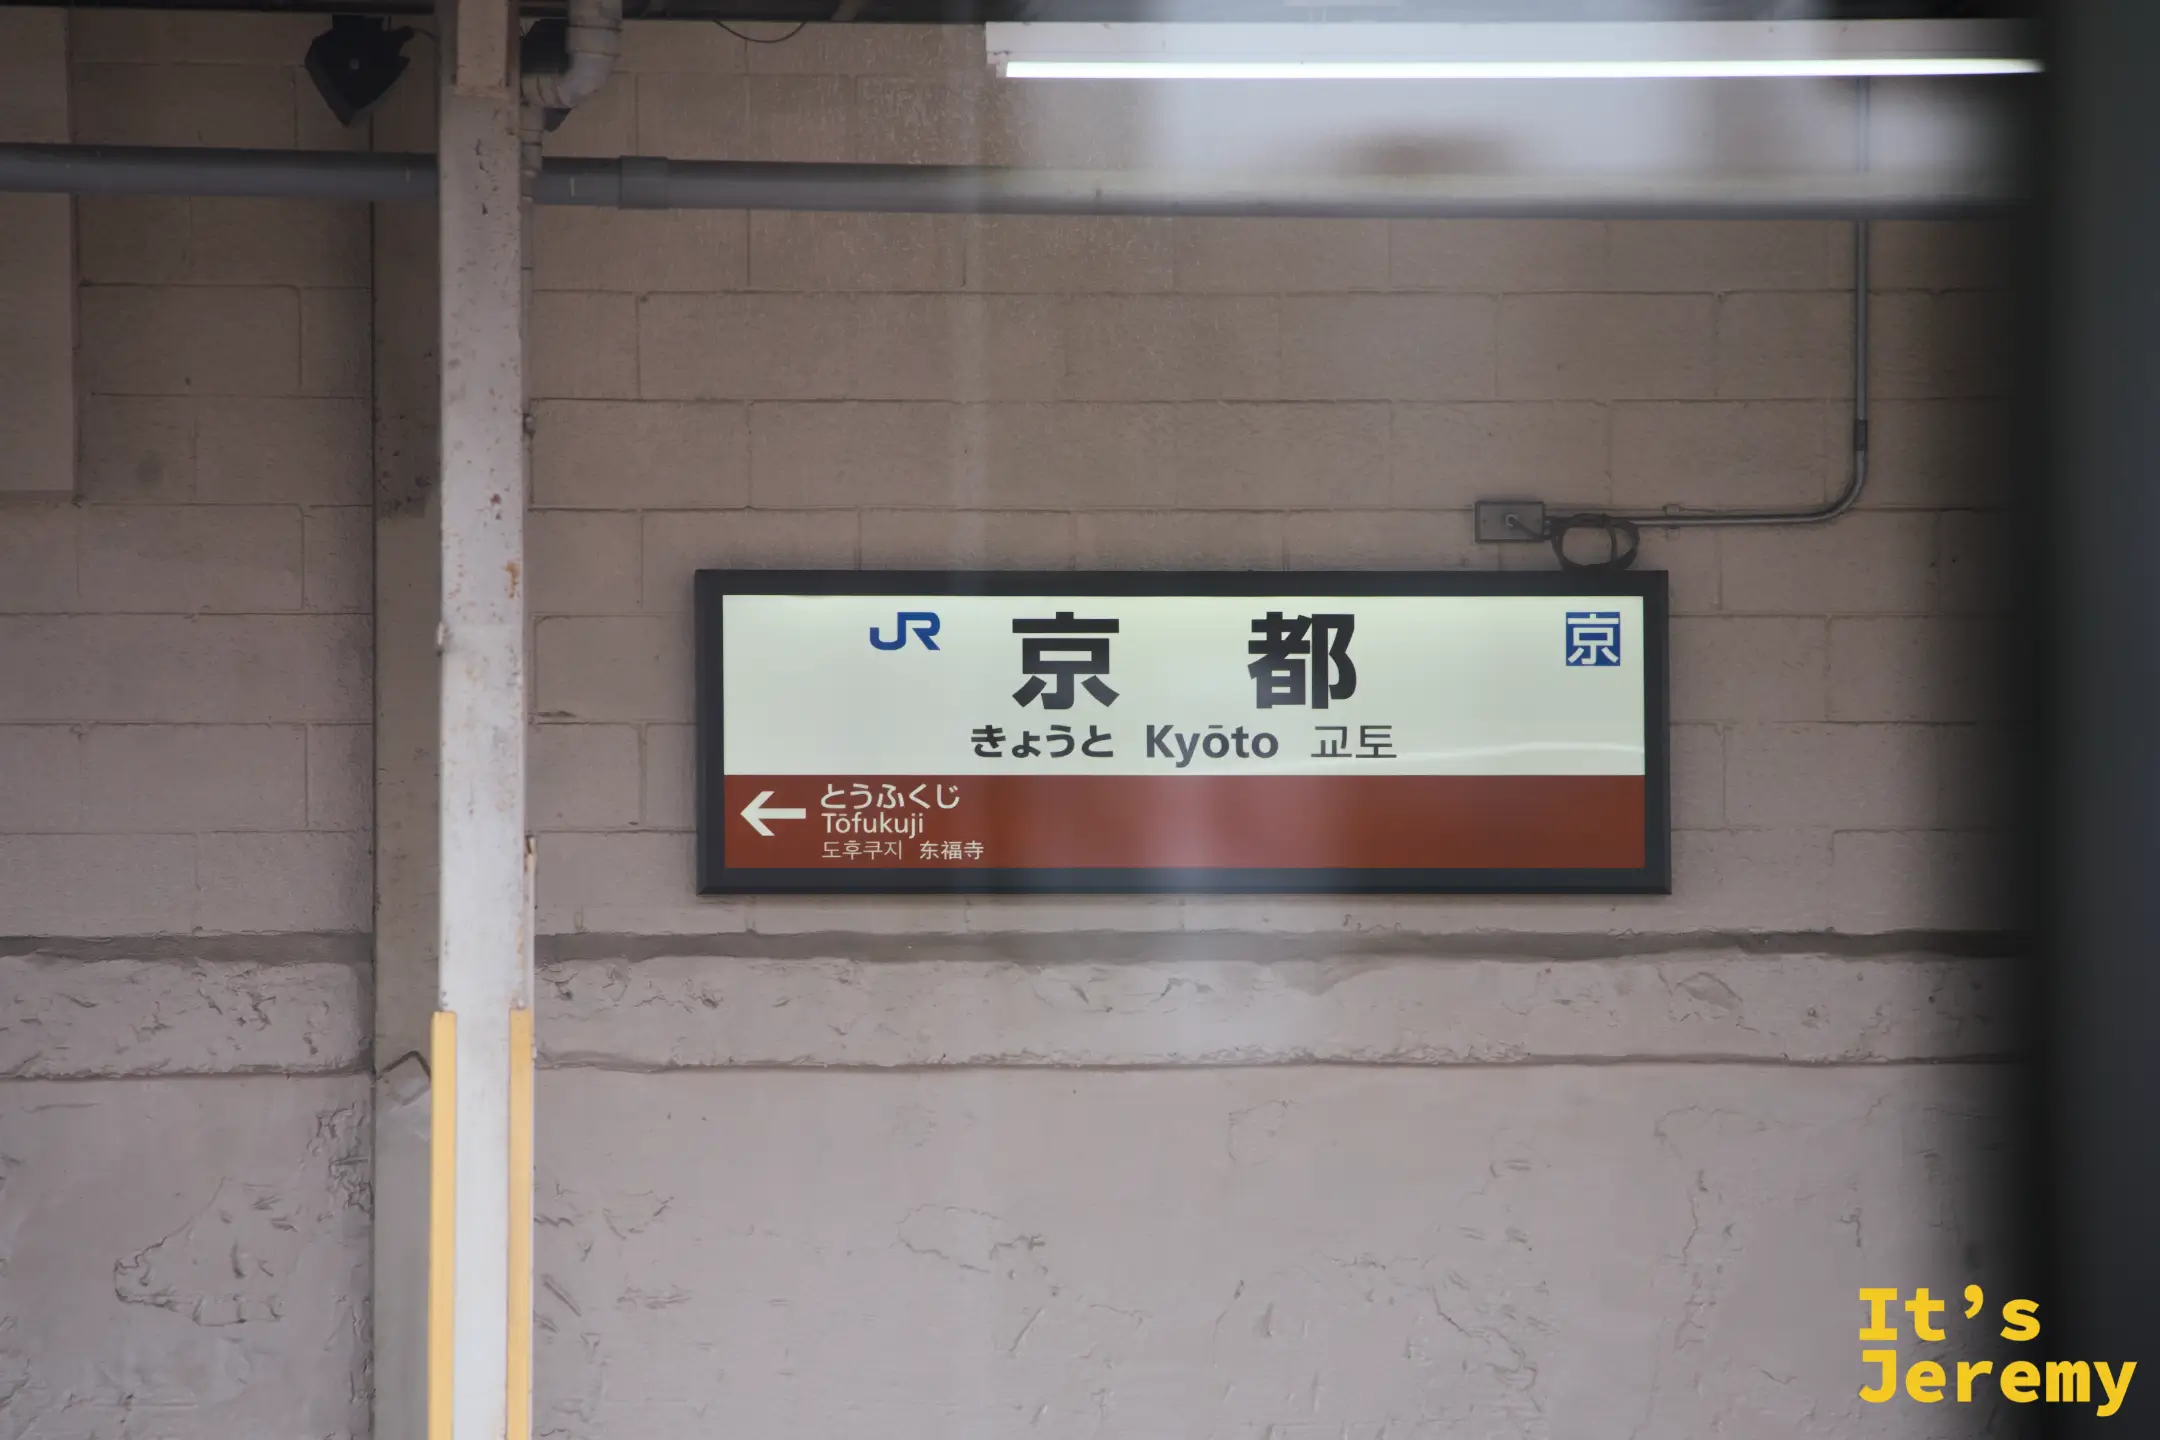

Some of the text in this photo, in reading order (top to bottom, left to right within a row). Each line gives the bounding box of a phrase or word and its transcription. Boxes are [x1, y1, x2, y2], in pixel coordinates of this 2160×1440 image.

[869, 611, 940, 650] JR
[1567, 612, 1620, 666] 京
[971, 724, 1398, 768] きょうと Kyōto 교토
[820, 783, 960, 810] とうふくじ
[821, 811, 924, 839] Tōfukuji
[821, 840, 985, 861] 도후쿠지 东福寺
